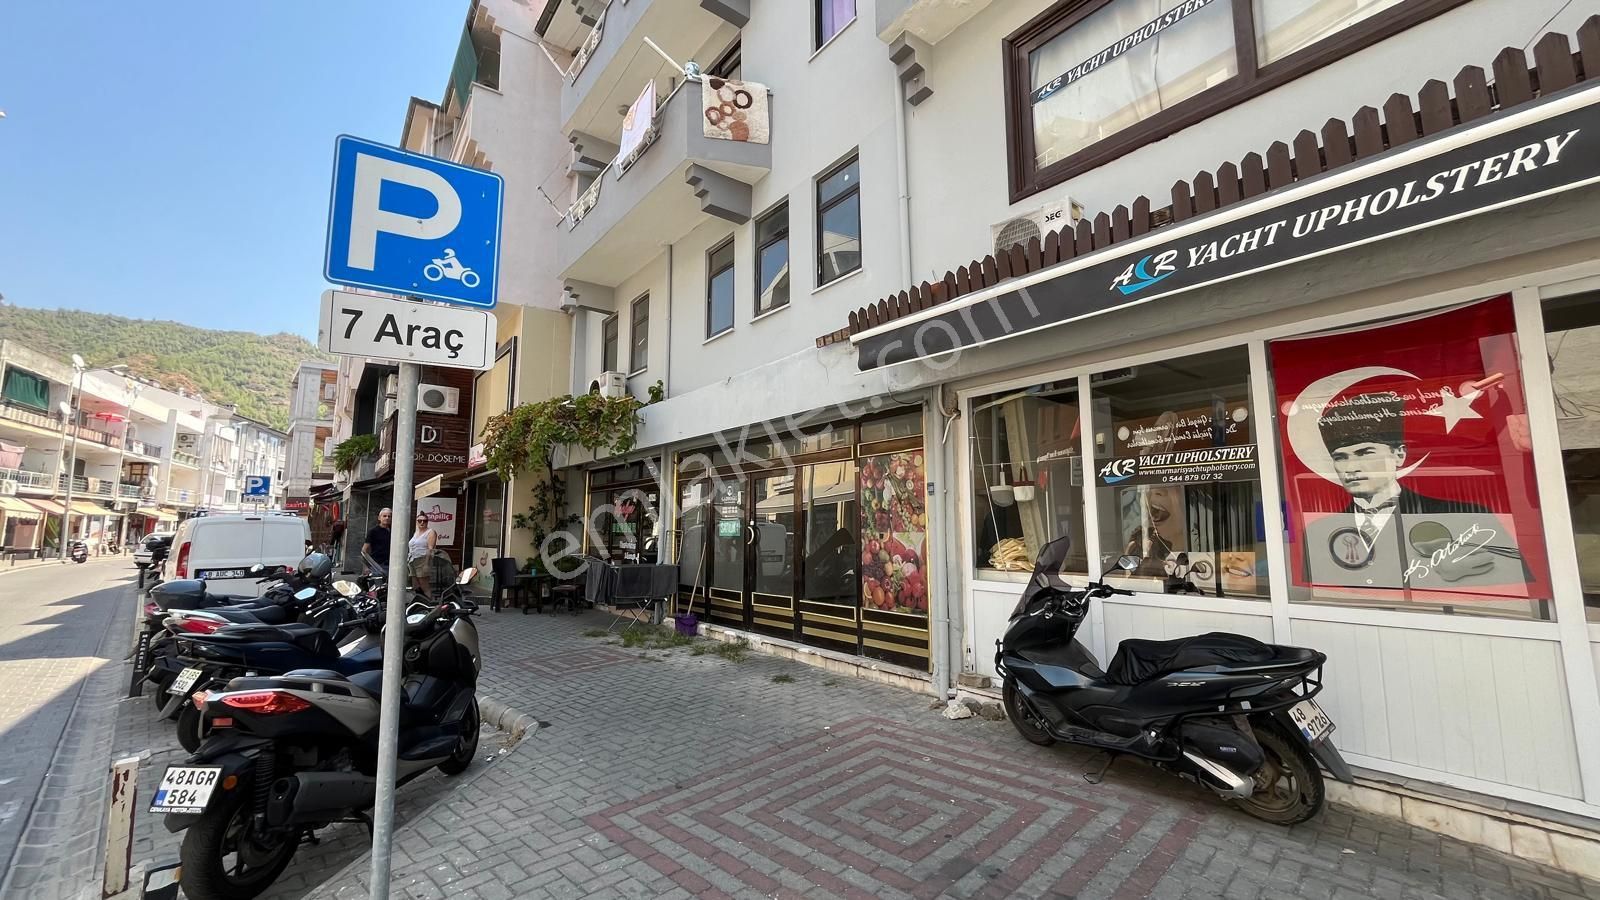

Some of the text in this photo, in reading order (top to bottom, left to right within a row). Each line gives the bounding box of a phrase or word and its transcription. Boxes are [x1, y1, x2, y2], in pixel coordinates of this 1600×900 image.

[1067, 48, 1111, 84] YACHT
[347, 152, 462, 271] P
[1108, 128, 1580, 294] ACR YACHT UPHOLSTERY
[341, 308, 464, 358] 7 Araç
[1098, 446, 1255, 479] ACR YACHT UPHOLSTERY
[1138, 462, 1256, 476] www.marmarisyachtupholstery.com
[1184, 474, 1199, 482] 879
[1292, 708, 1306, 723] 48
[1307, 712, 1327, 736] 9726
[166, 770, 217, 785] 48AGR
[167, 789, 197, 805] 584
